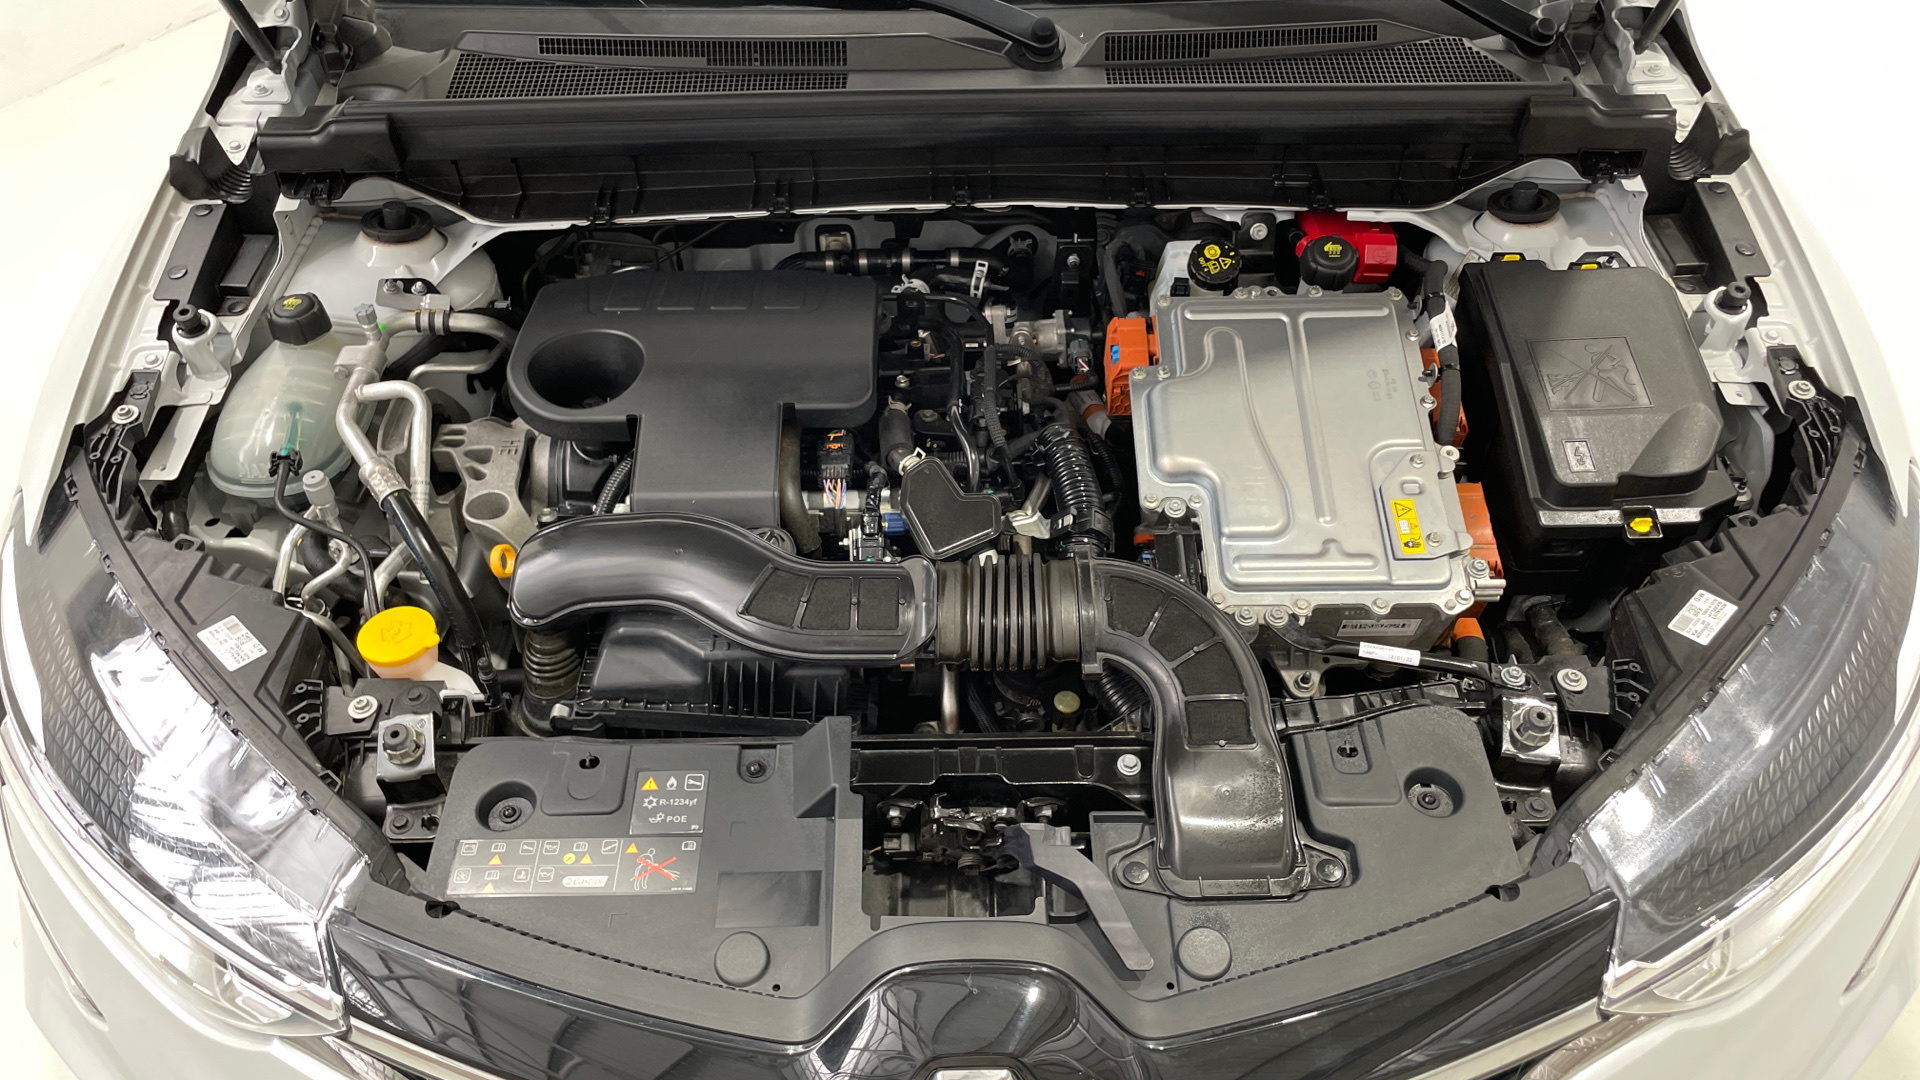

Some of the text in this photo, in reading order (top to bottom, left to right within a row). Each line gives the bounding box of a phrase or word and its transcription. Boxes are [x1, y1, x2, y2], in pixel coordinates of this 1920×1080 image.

[1198, 257, 1207, 267] DOT
[659, 798, 698, 807] R-1234yf
[666, 815, 687, 823] POE
[573, 877, 603, 885] Castrol
